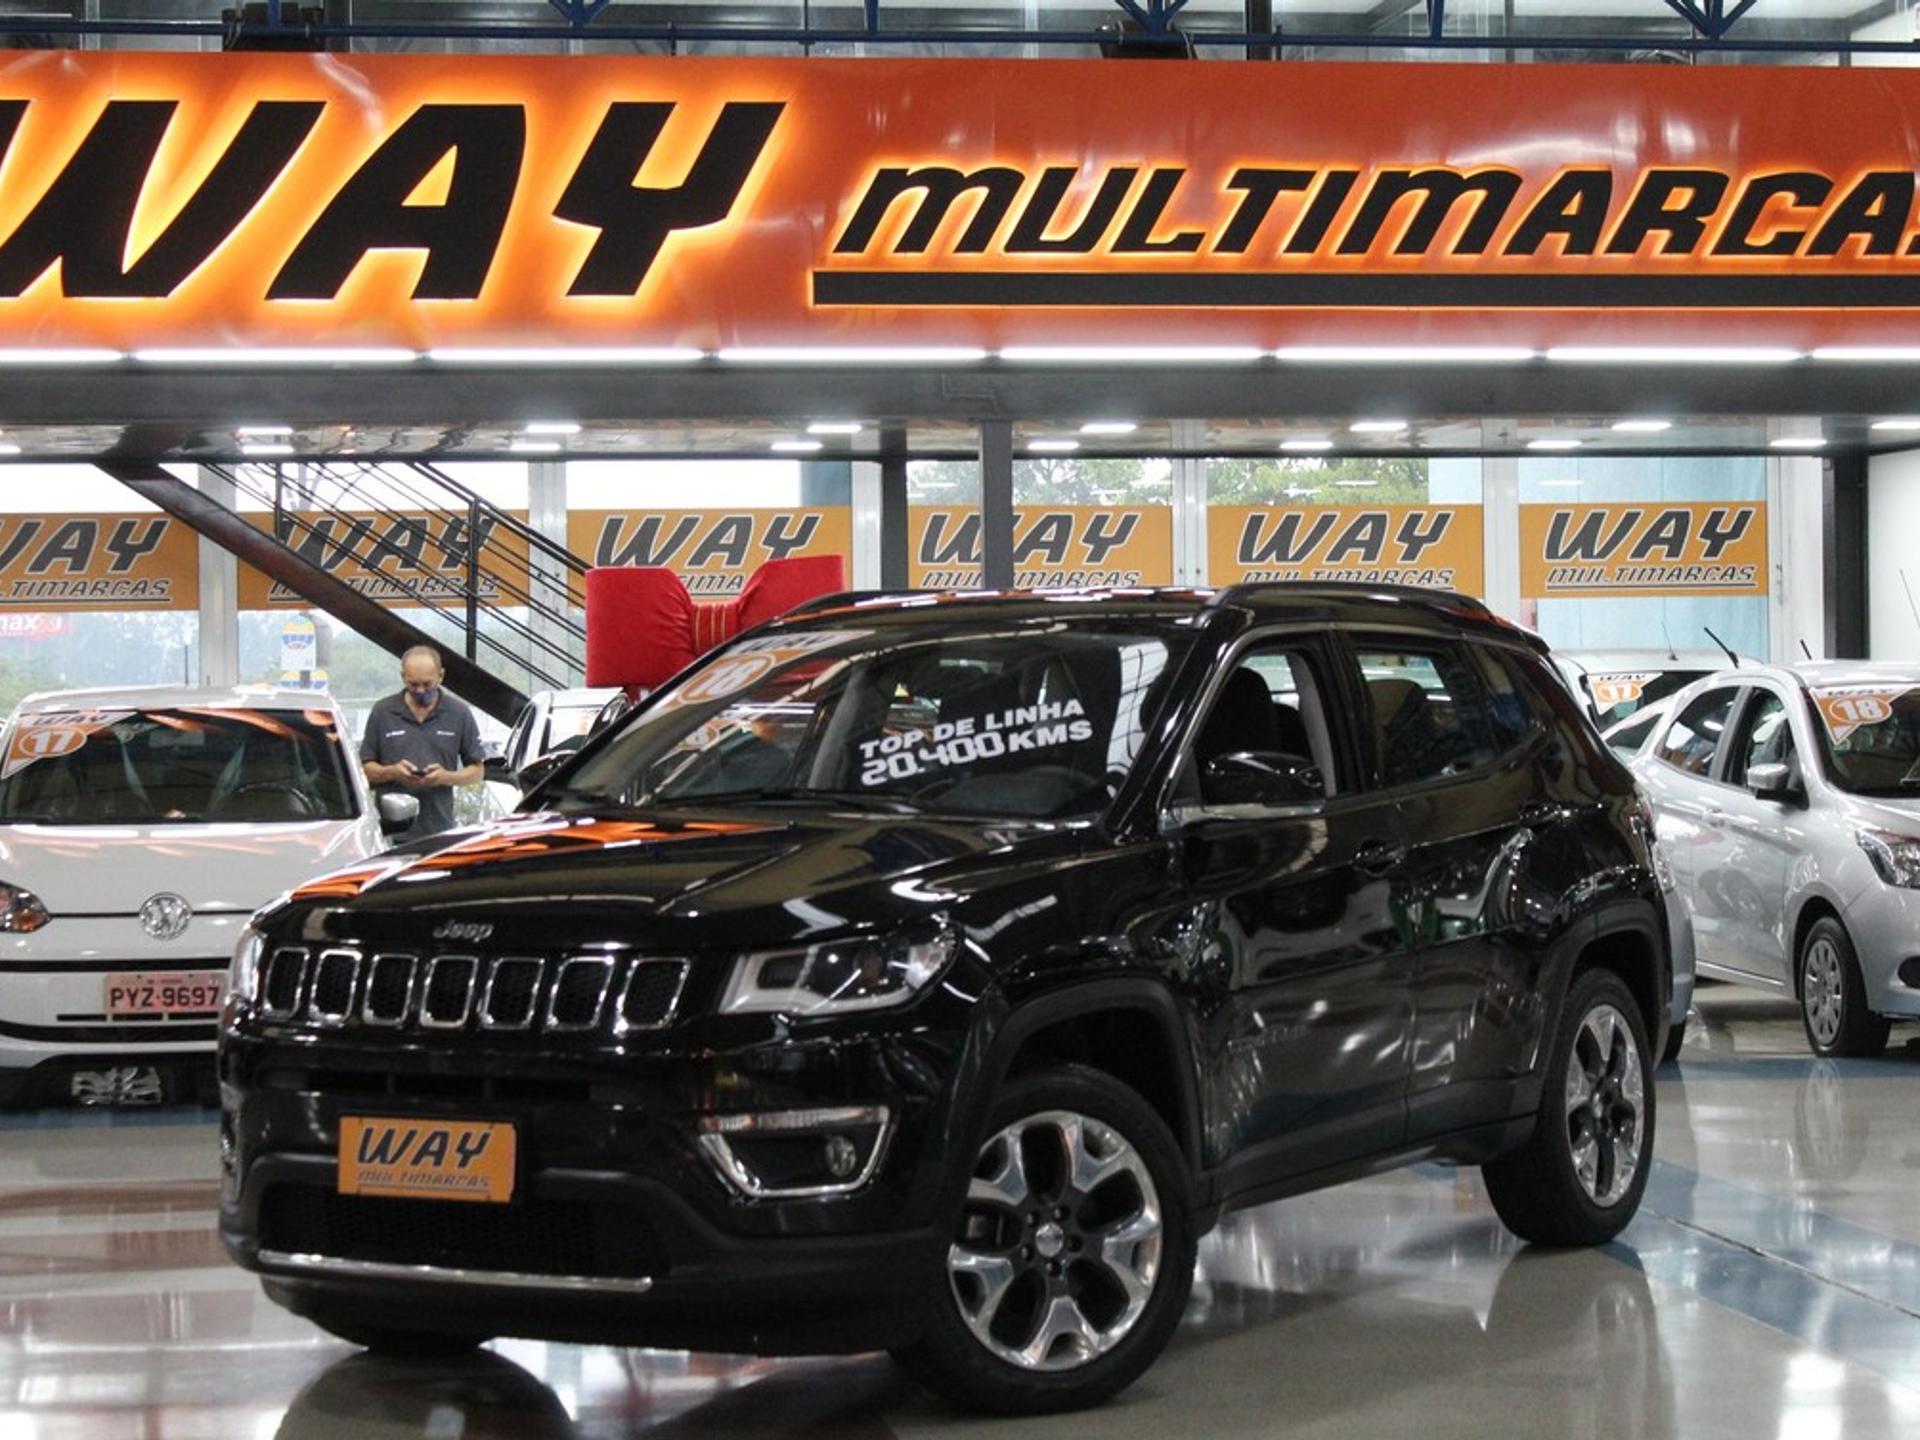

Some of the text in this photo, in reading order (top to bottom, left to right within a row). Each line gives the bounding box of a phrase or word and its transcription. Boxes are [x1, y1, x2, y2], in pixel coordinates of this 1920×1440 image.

[0, 98, 1920, 300] WAY MULTIMARCA
[595, 514, 822, 568] WAY
[1237, 511, 1455, 565] WAY
[1544, 508, 1755, 562] WAY
[1547, 565, 1756, 583] MULTIMARCAS
[860, 699, 1086, 759] TOP DE LINHA
[1838, 700, 1884, 721] 18
[30, 730, 77, 752] 17
[357, 1127, 491, 1168] WAY
